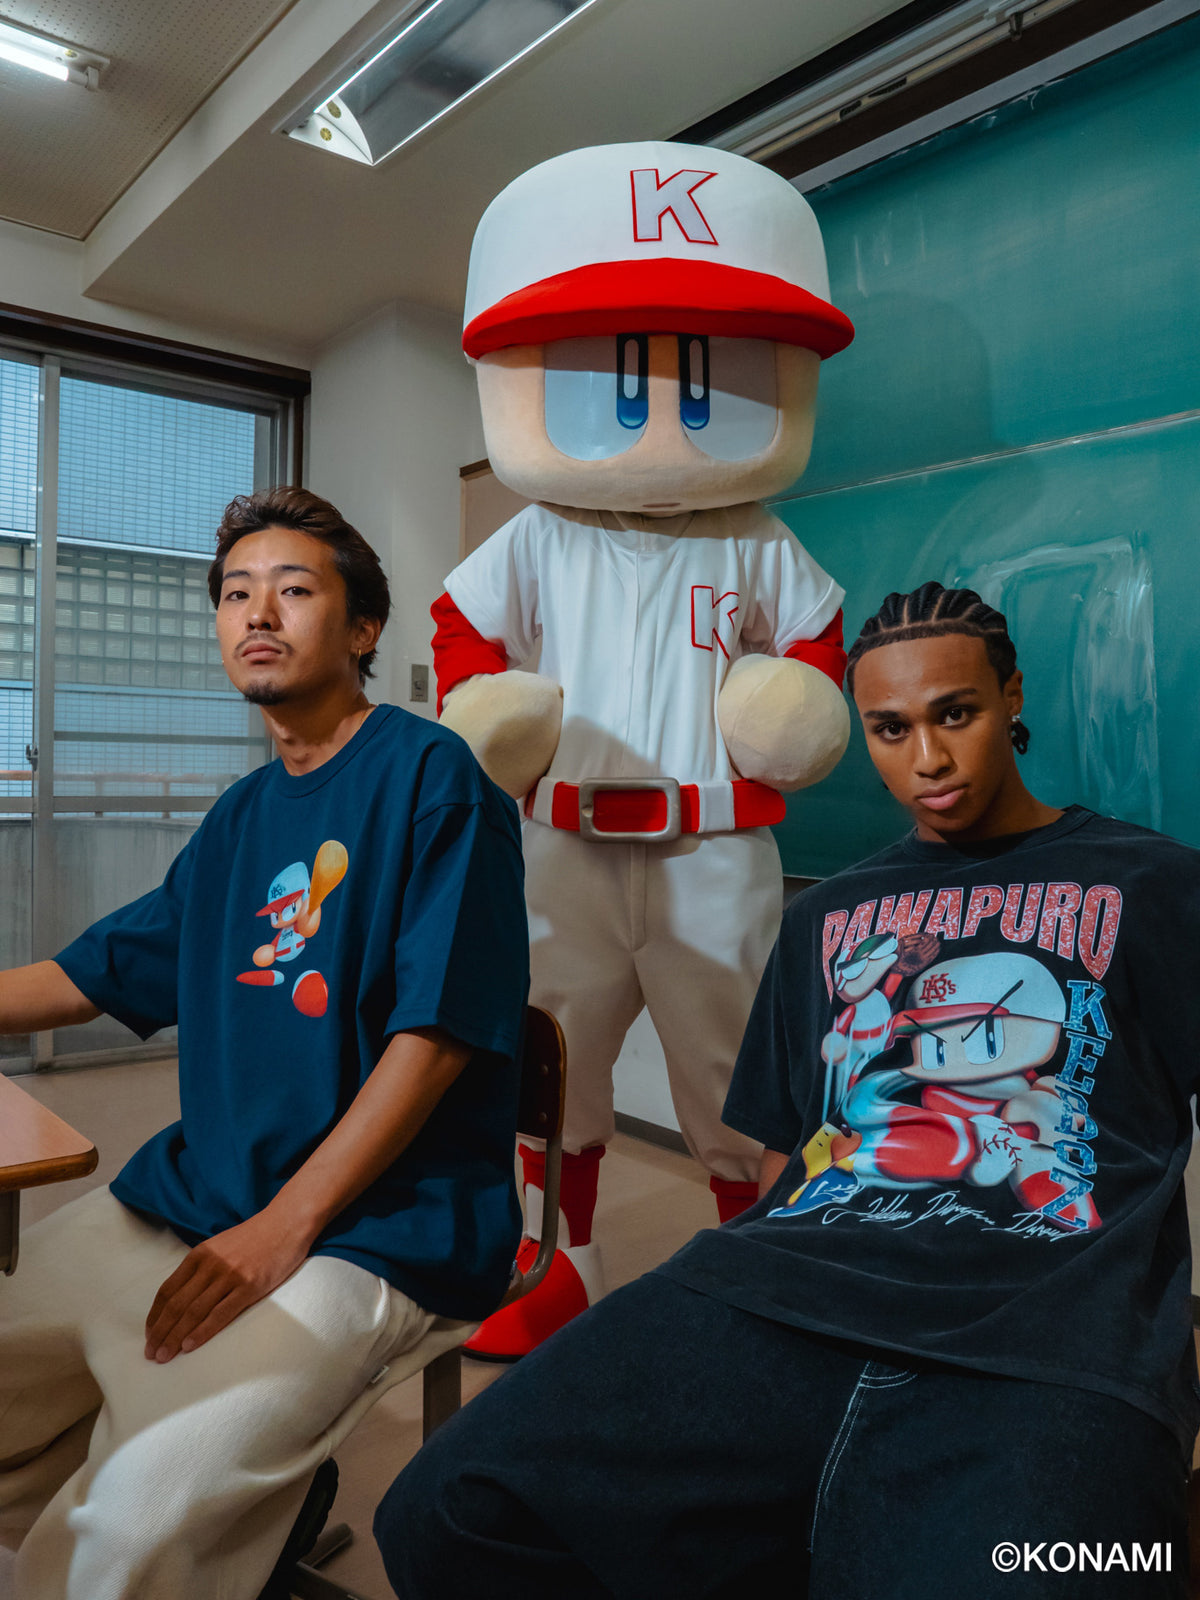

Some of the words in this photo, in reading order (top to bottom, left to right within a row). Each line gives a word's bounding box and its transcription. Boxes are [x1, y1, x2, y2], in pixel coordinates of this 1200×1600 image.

[630, 168, 719, 246] K
[691, 585, 740, 661] K
[822, 881, 1123, 1005] PAWAPURO
[1041, 979, 1112, 1230] KEBOZ
